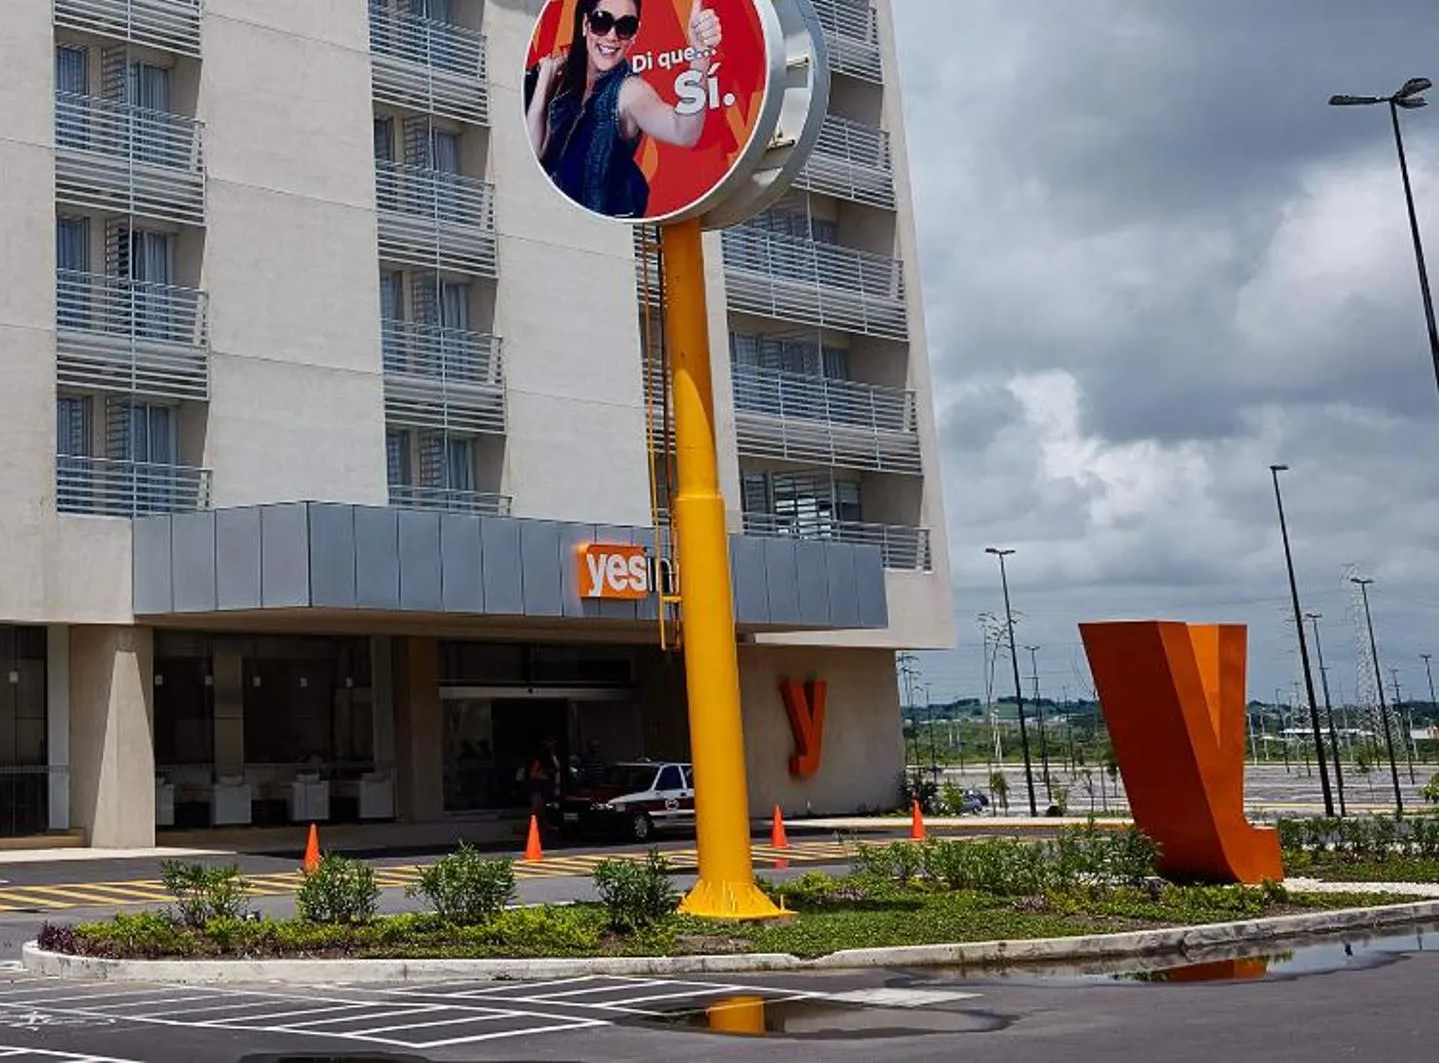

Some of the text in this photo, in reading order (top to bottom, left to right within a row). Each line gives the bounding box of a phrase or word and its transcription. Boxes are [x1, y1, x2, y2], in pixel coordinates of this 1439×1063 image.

[632, 51, 653, 73] Di
[674, 62, 736, 114] Sí.
[586, 554, 647, 597] yes
